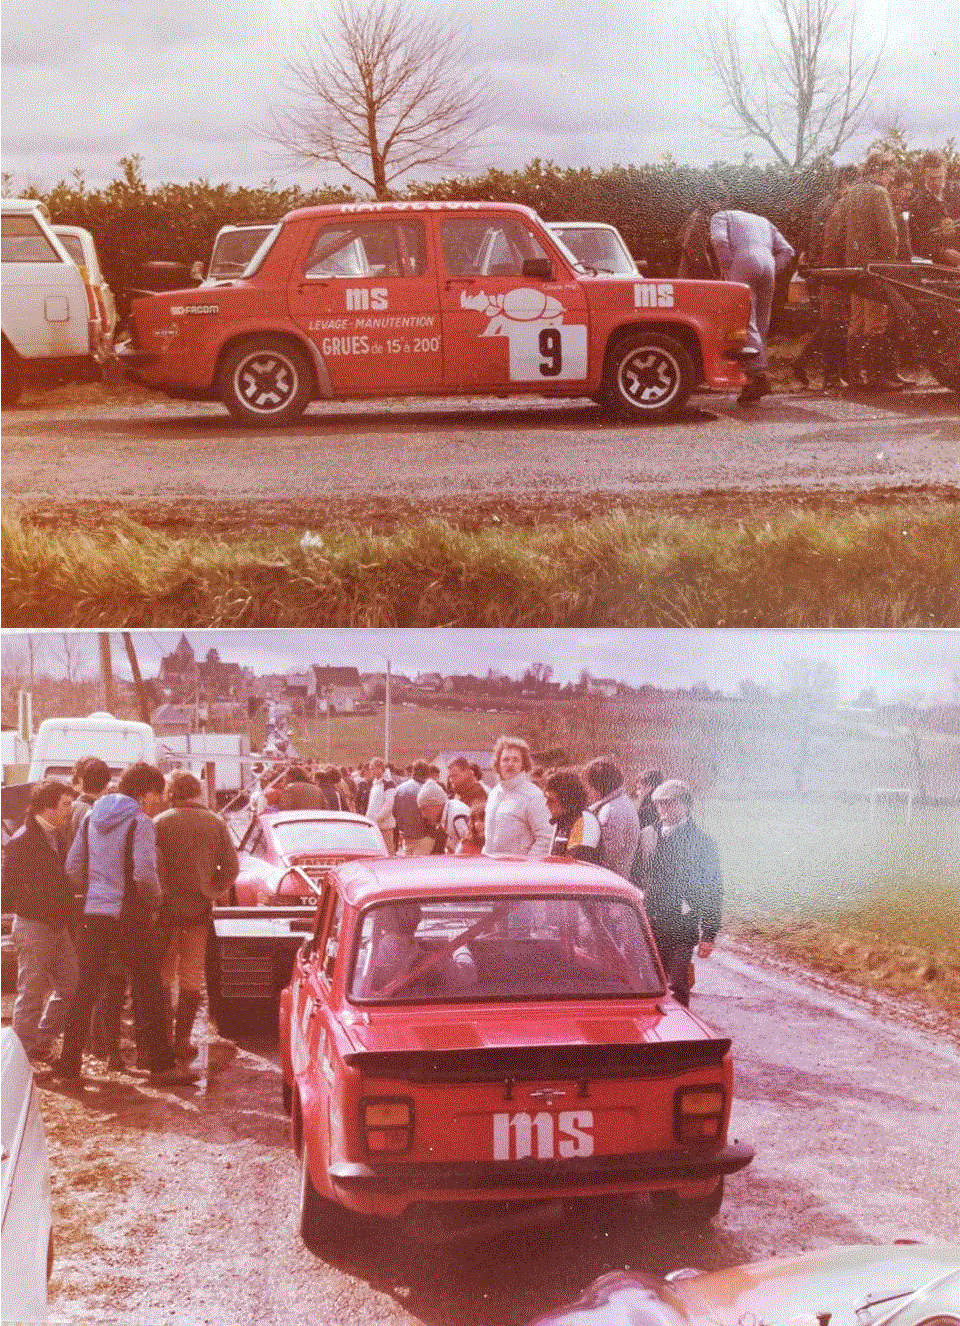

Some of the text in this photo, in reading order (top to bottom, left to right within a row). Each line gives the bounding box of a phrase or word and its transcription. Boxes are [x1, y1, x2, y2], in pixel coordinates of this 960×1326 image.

[308, 318, 348, 331] LEVAGE
[355, 316, 435, 330] MANUTENTION
[322, 335, 370, 355] GRUES
[538, 328, 562, 377] 9
